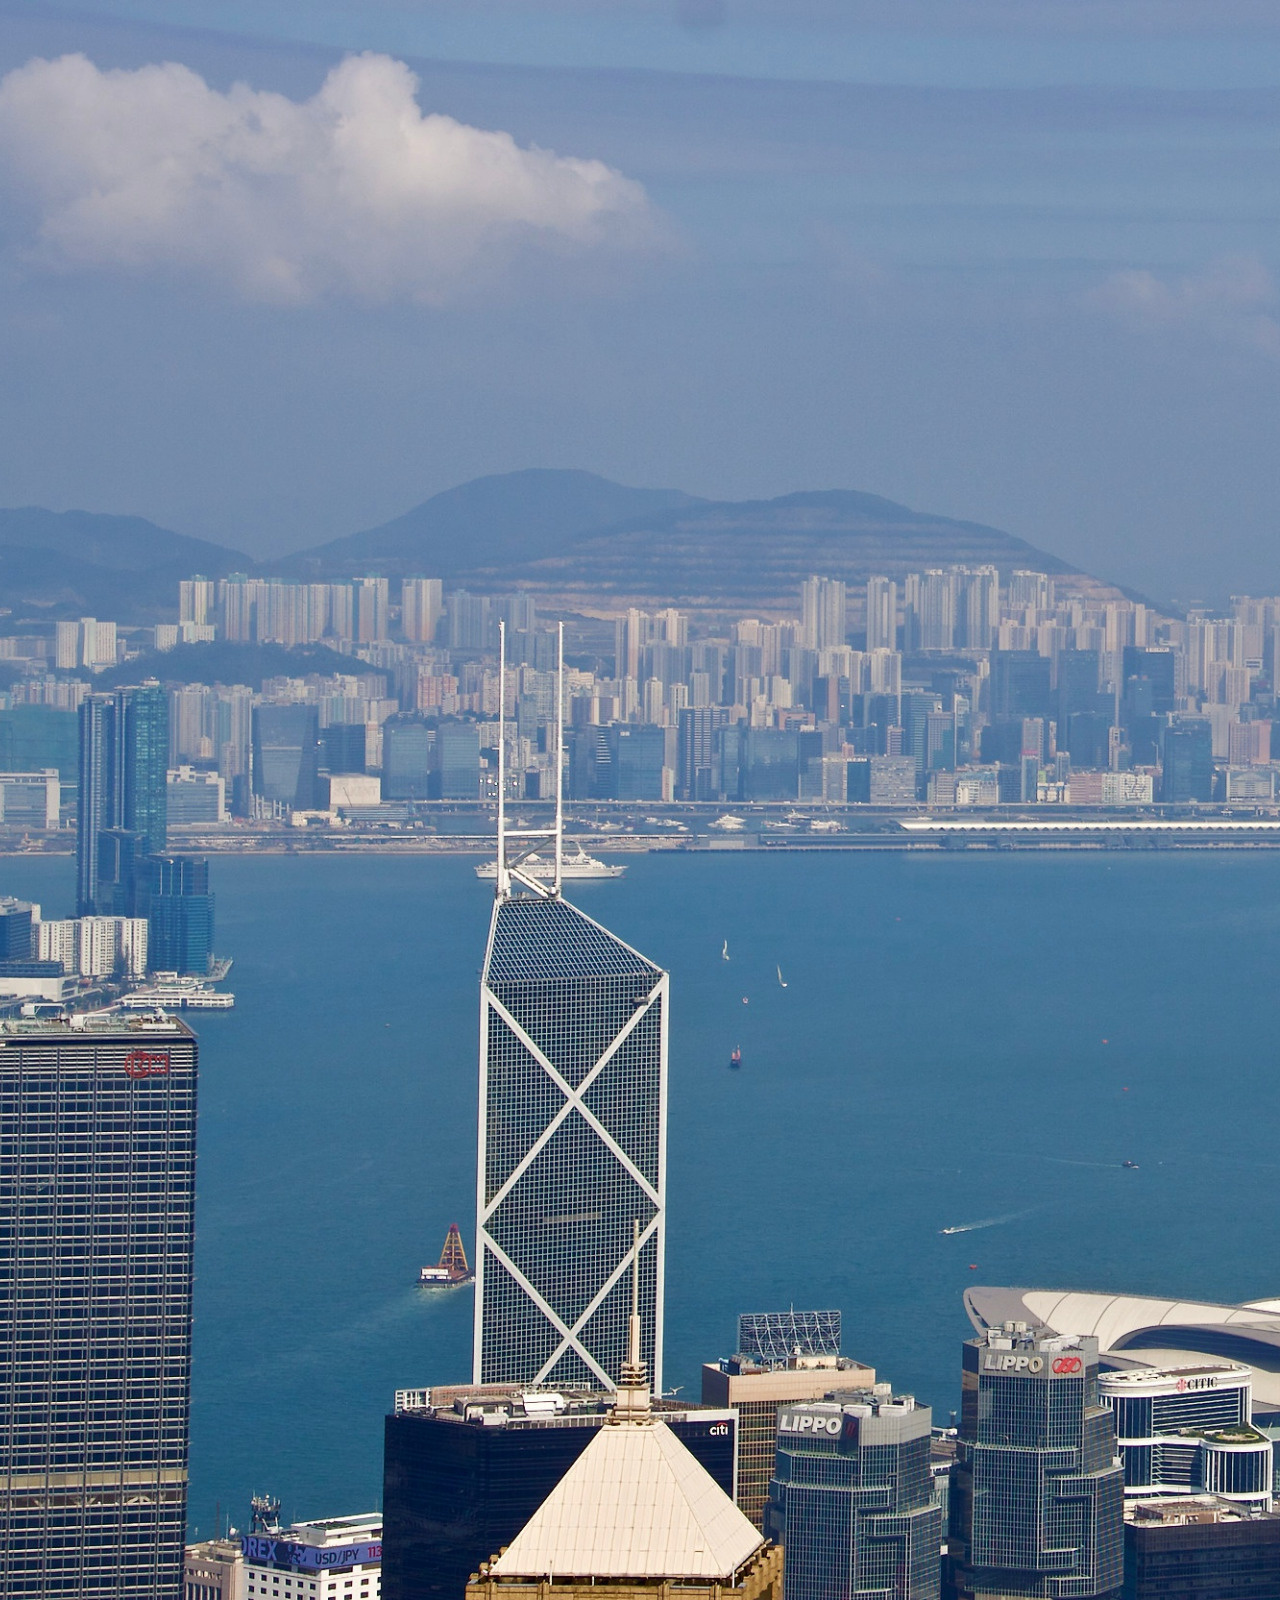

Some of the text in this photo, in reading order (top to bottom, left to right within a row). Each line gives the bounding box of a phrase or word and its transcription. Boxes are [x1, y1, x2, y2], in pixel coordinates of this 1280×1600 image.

[984, 1355, 1043, 1374] LIPPO
[1187, 1377, 1218, 1390] CITIC
[709, 1423, 728, 1435] citi
[779, 1414, 842, 1435] LIPPO
[315, 1548, 359, 1565] USD/JPY
